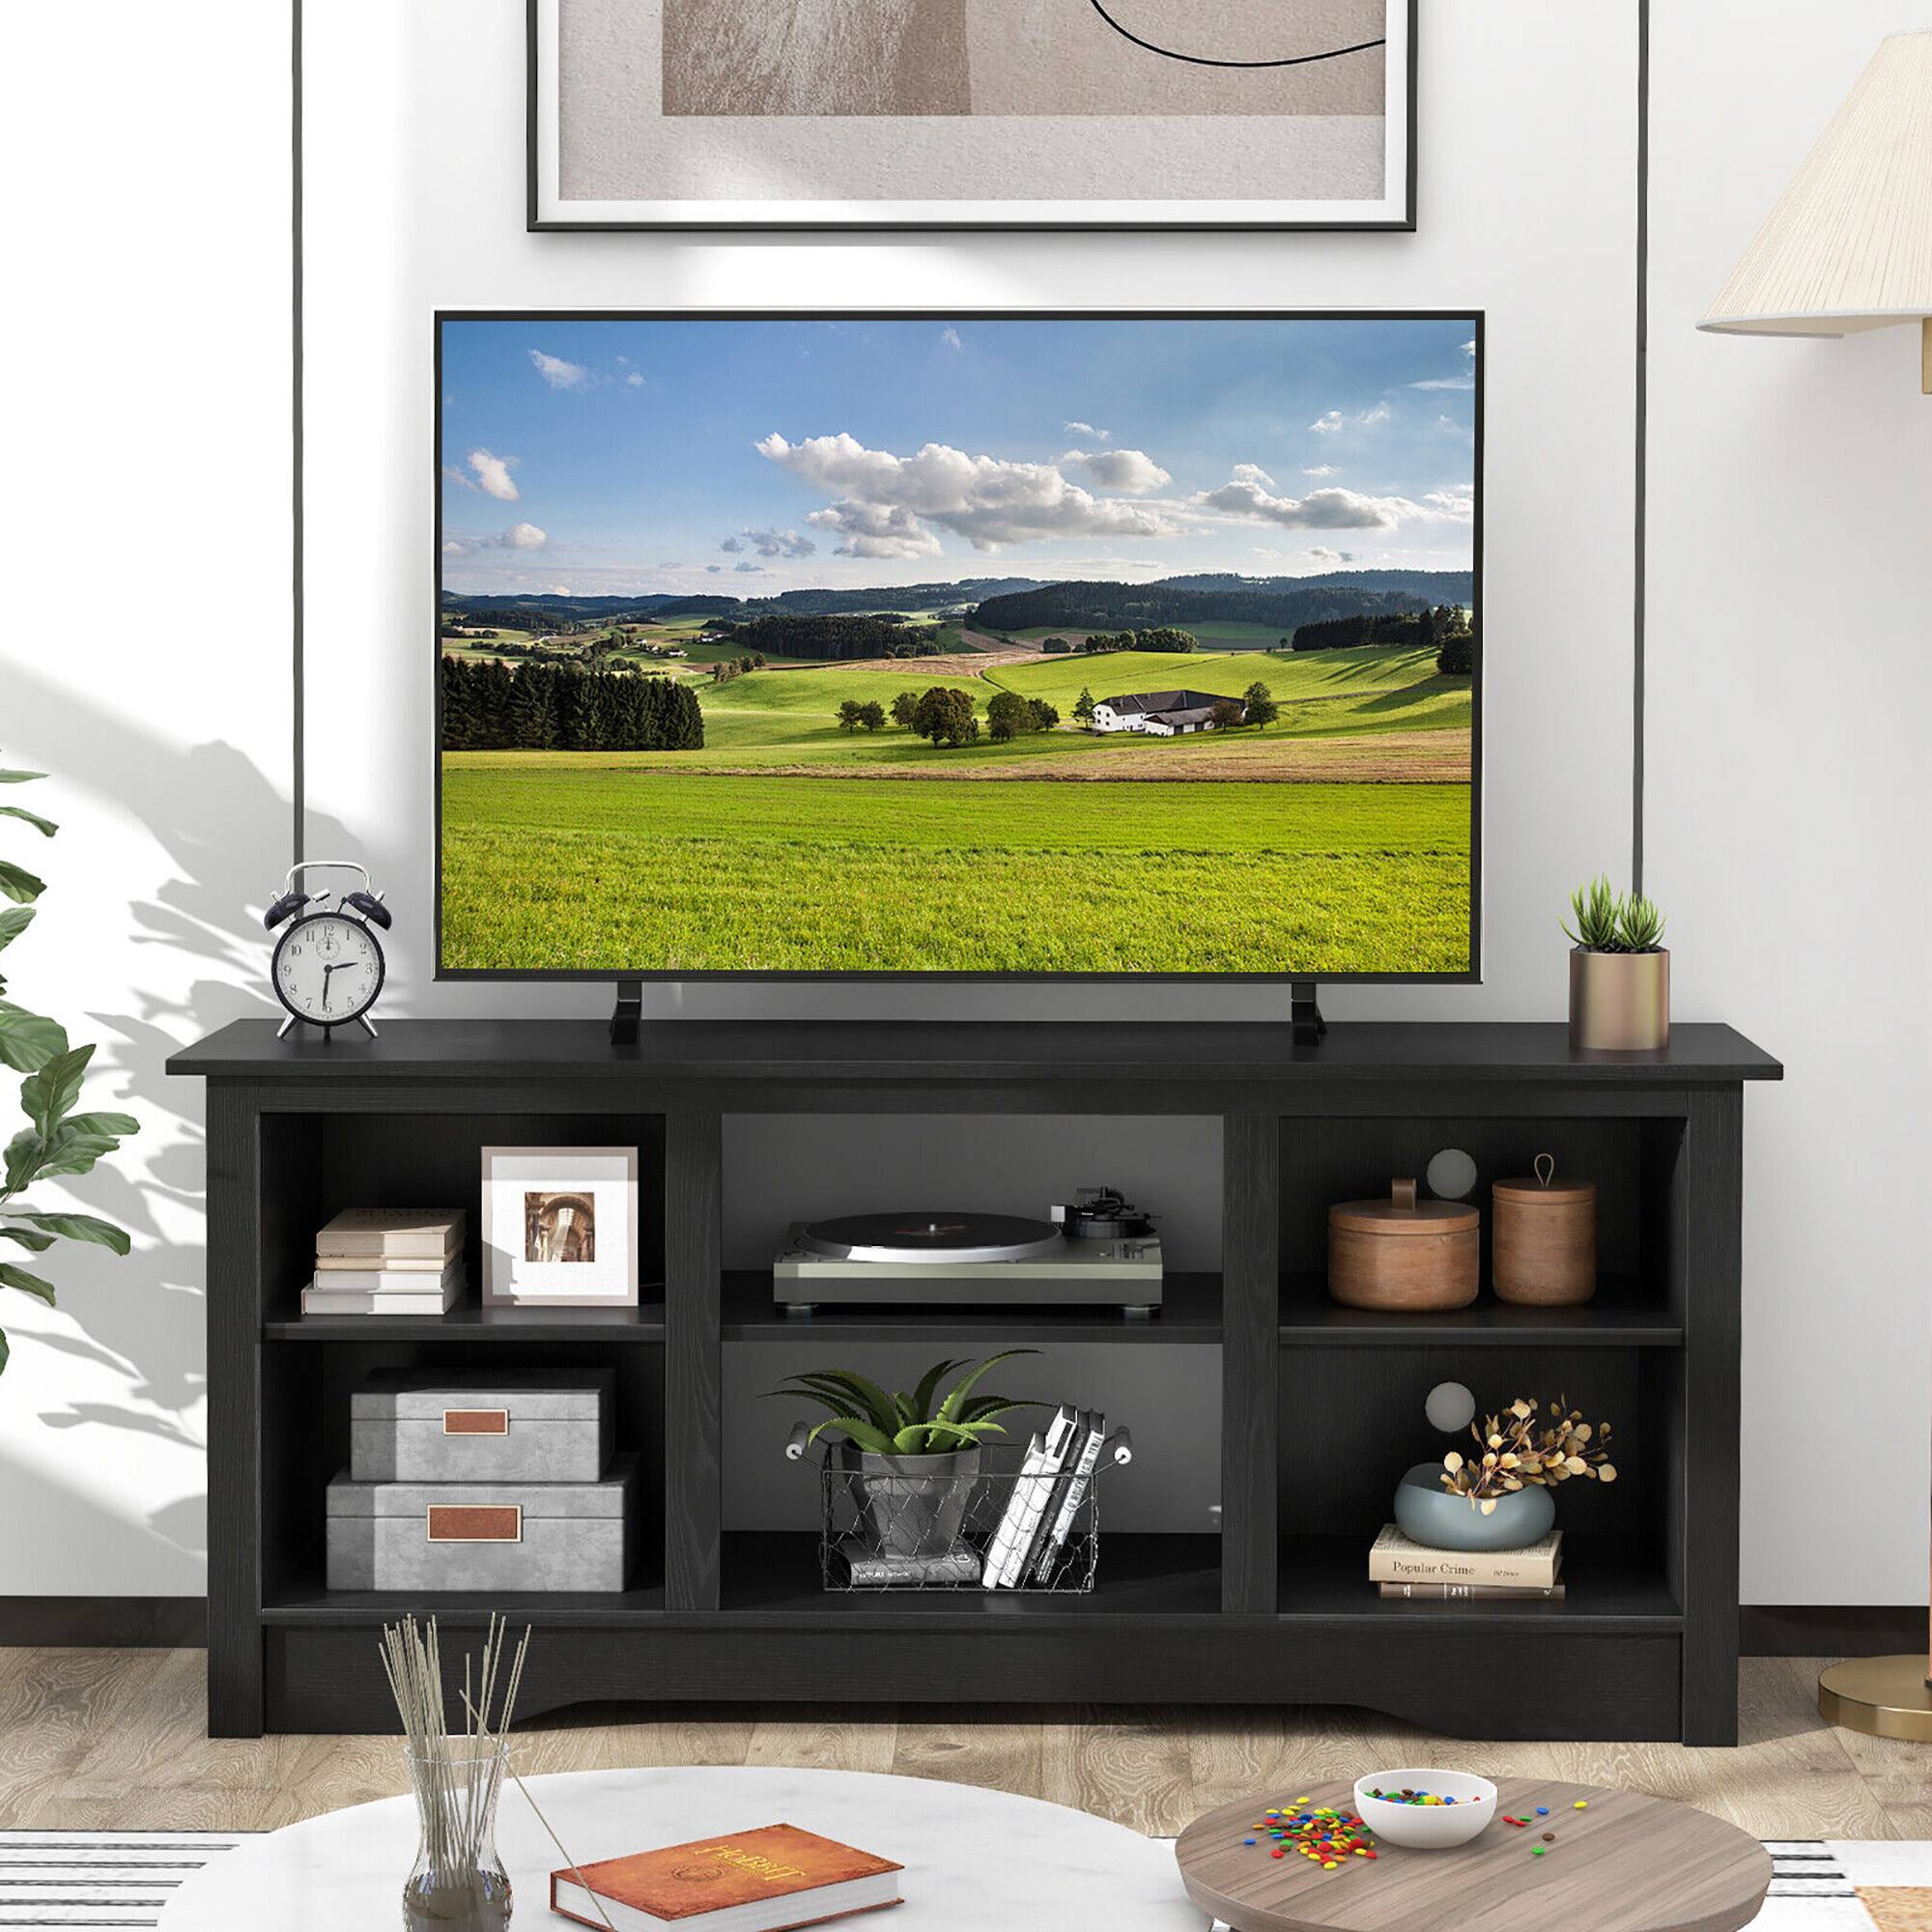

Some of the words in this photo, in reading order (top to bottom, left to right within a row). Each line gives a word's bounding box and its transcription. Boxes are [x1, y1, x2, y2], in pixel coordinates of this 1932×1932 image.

[306, 930, 315, 942] 11
[325, 925, 334, 936] 12
[291, 945, 302, 956] 10
[359, 943, 367, 954] 2
[284, 965, 292, 977] 9
[365, 962, 373, 975] 3
[291, 984, 298, 995] 8
[305, 997, 313, 1009] 7
[348, 996, 355, 1008] 5
[1393, 1561, 1437, 1575] Popular
[1440, 1563, 1476, 1576] Crime
